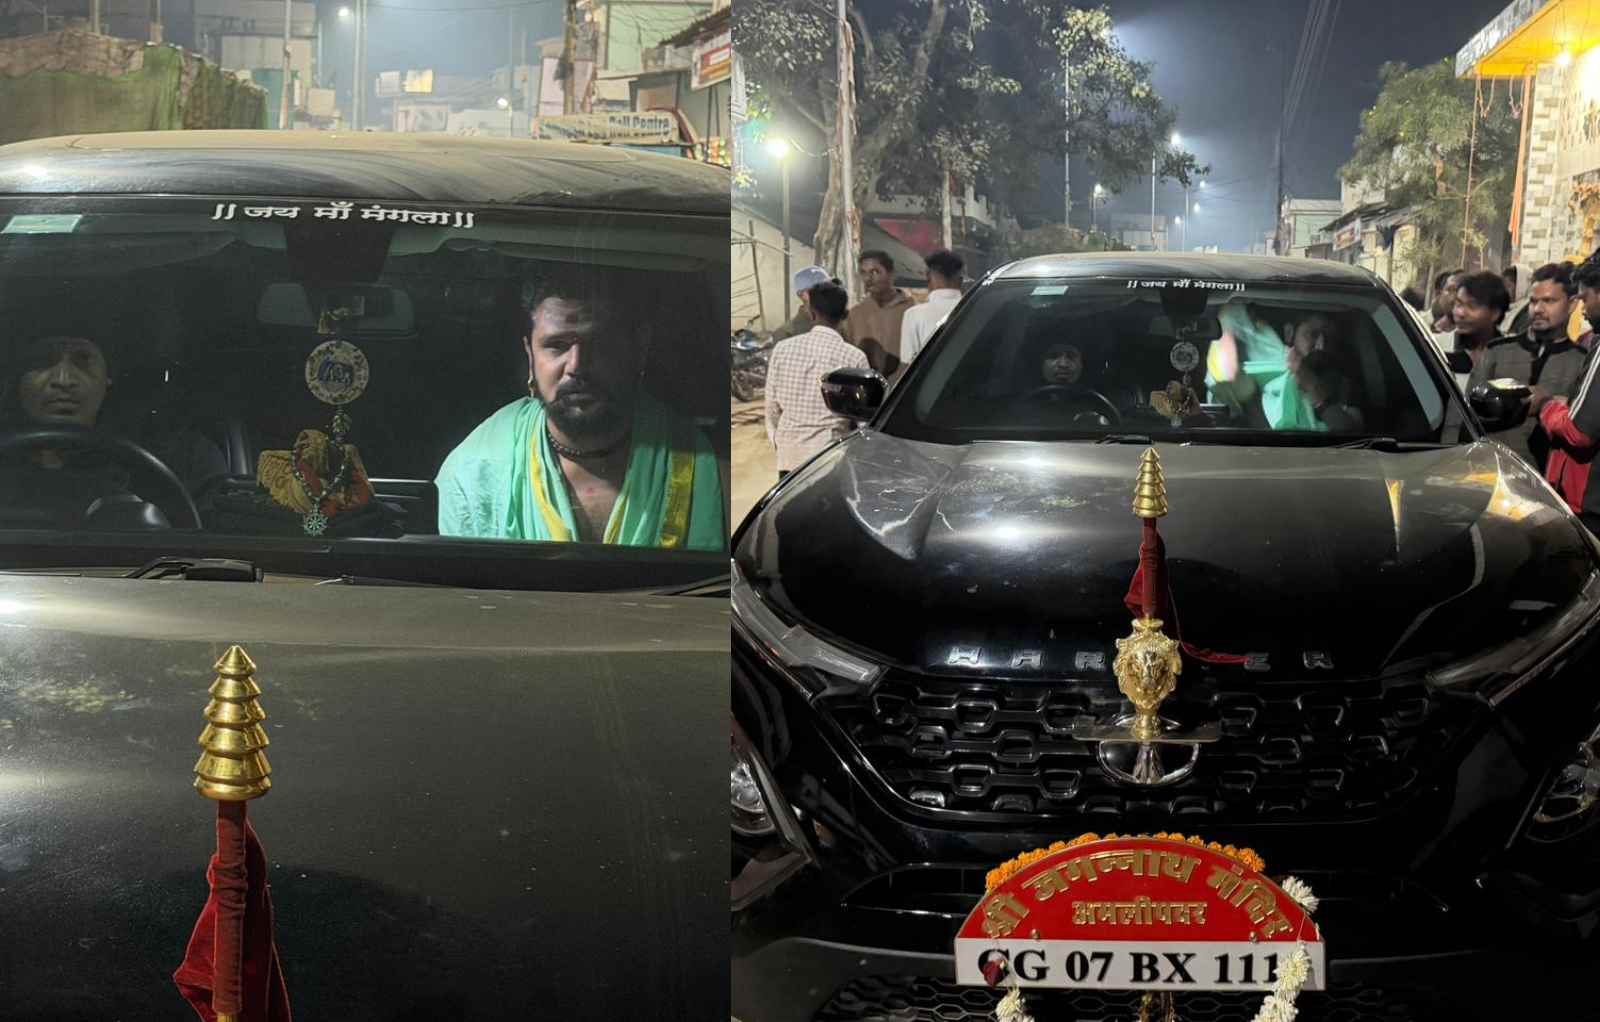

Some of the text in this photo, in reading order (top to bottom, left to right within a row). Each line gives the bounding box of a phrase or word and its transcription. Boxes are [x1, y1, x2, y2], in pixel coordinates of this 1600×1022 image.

[244, 206, 300, 219] जय
[314, 201, 354, 220] माँ
[947, 645, 1335, 672] HARER
[977, 849, 1295, 939] श्री जगन्नाथ मंदिर
[977, 948, 1051, 982] CG
[1065, 950, 1114, 983] 07
[1130, 952, 1198, 984] BX
